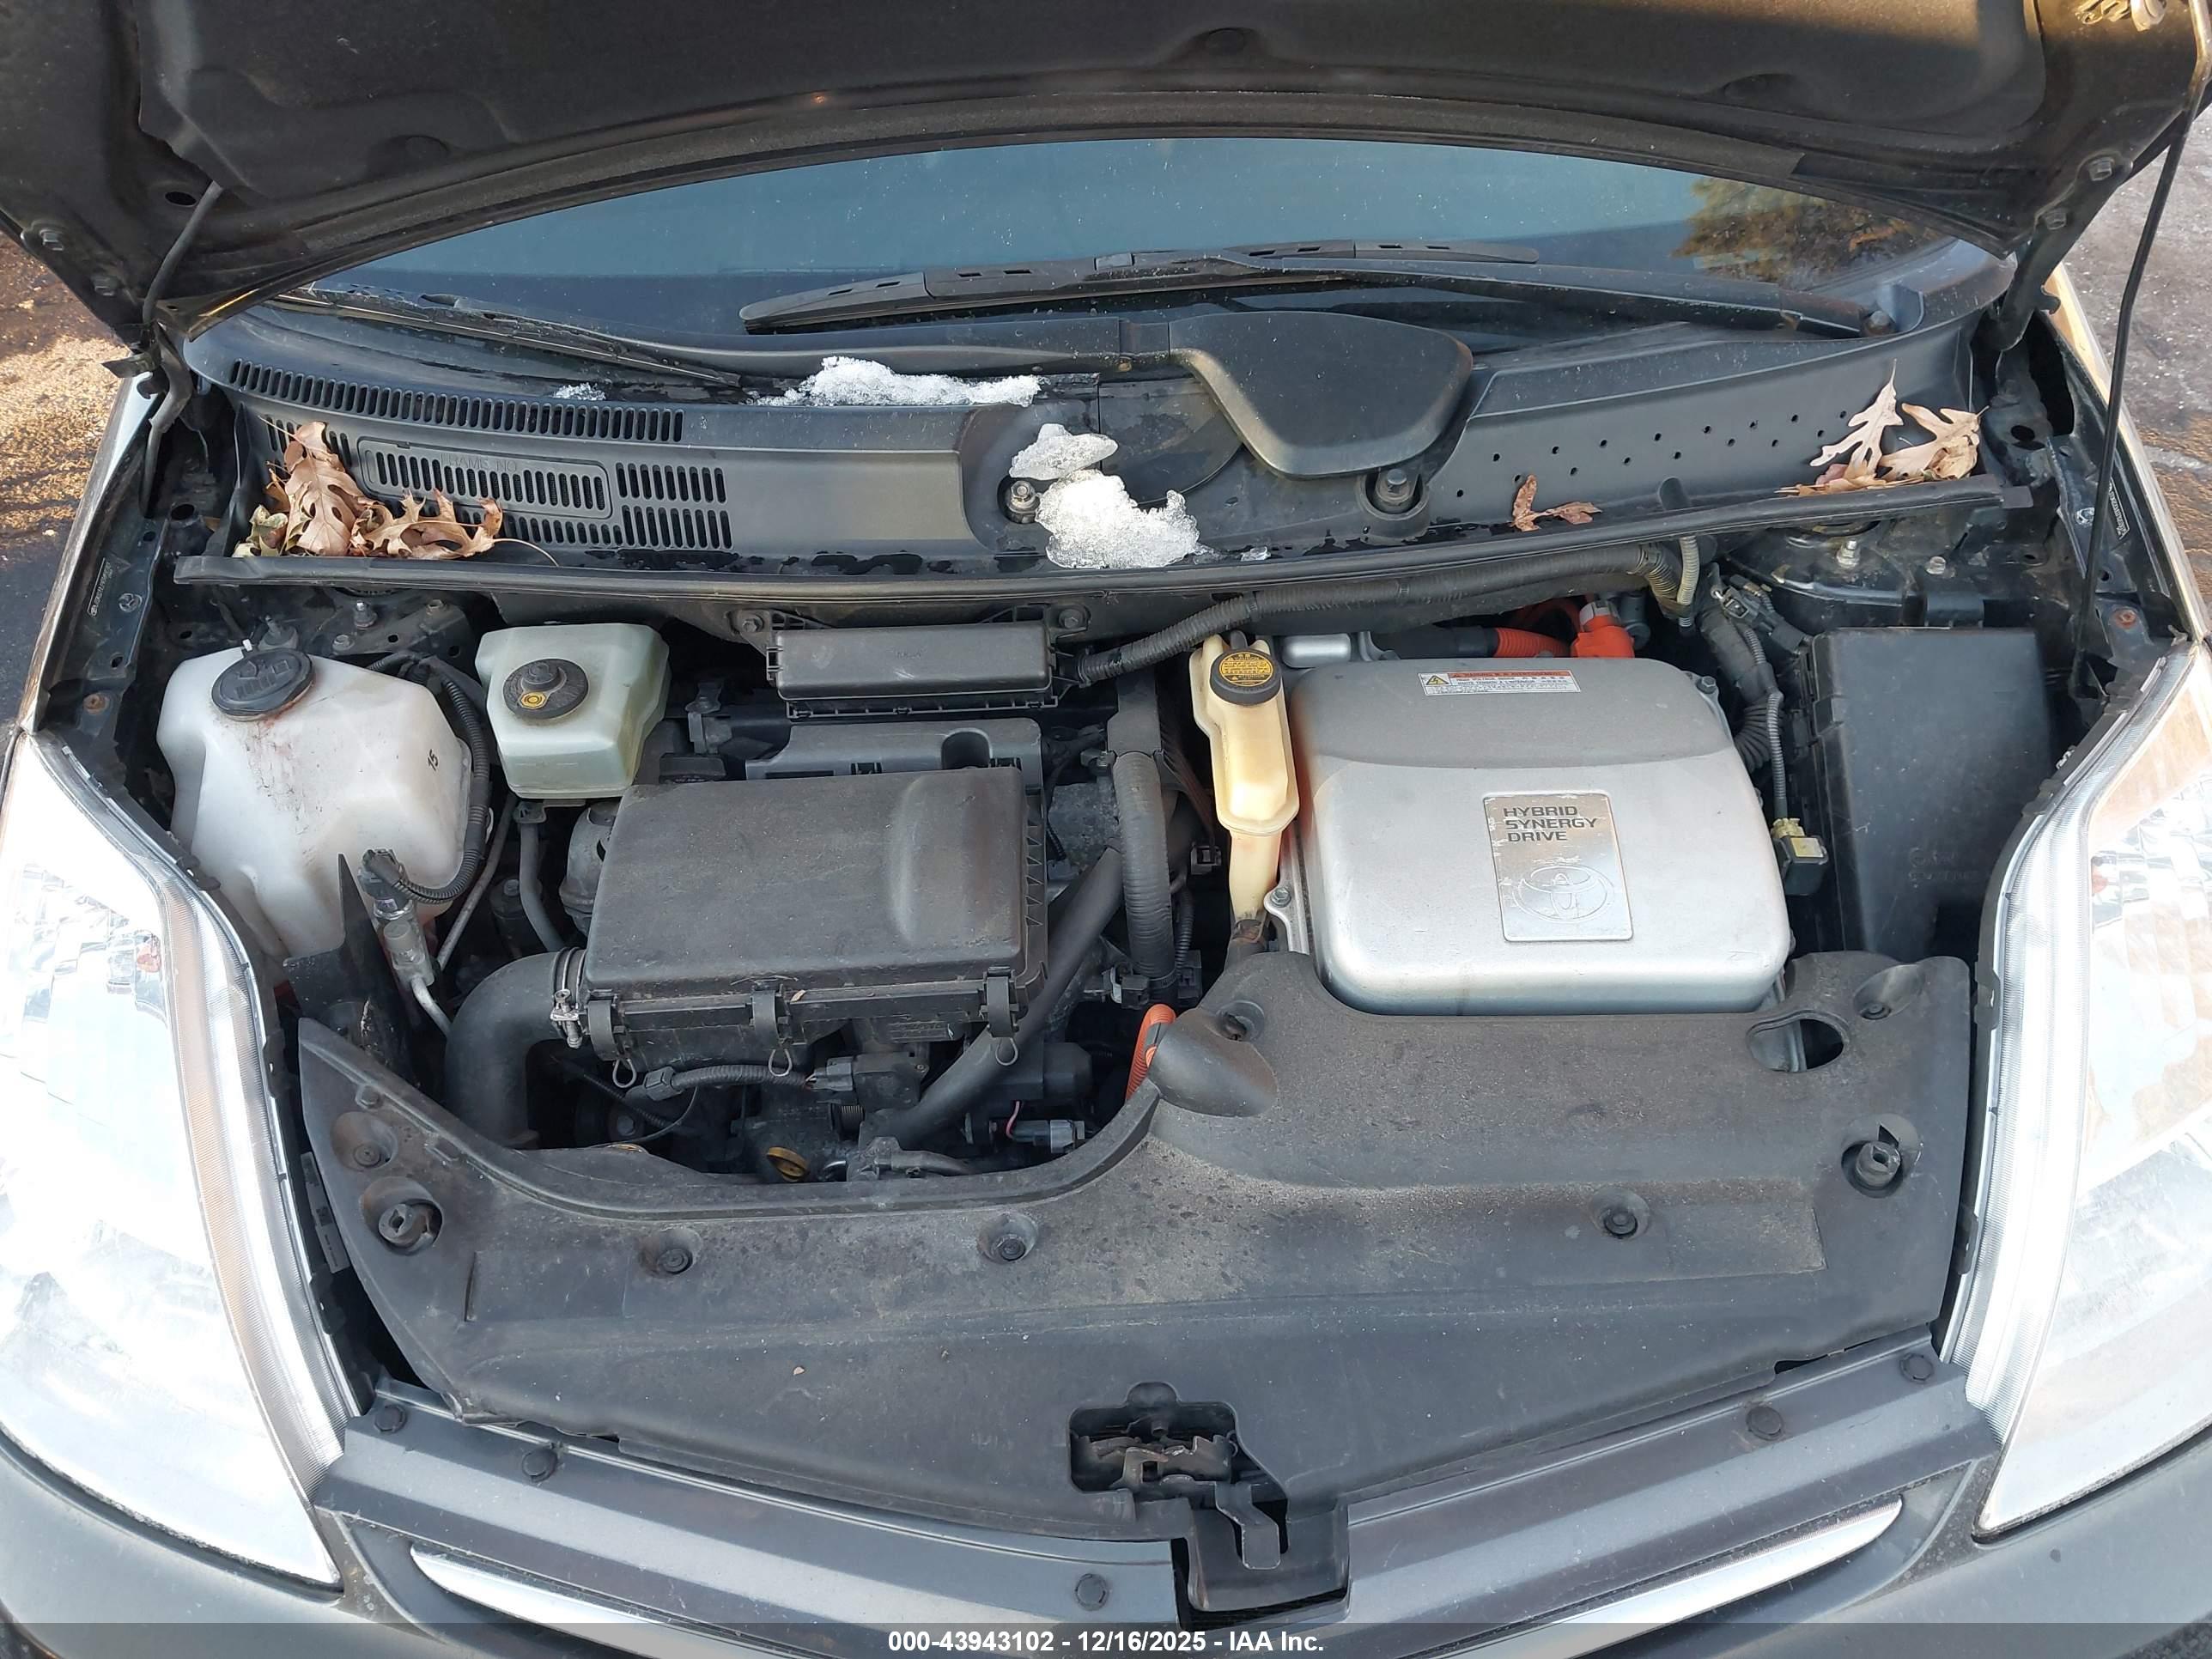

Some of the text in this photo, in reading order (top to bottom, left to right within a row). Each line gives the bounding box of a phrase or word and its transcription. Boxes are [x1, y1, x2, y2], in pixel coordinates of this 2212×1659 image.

[1503, 805, 1577, 817] HYBRID
[1504, 817, 1598, 830] SYNERGY
[1507, 830, 1568, 842] DRIVE
